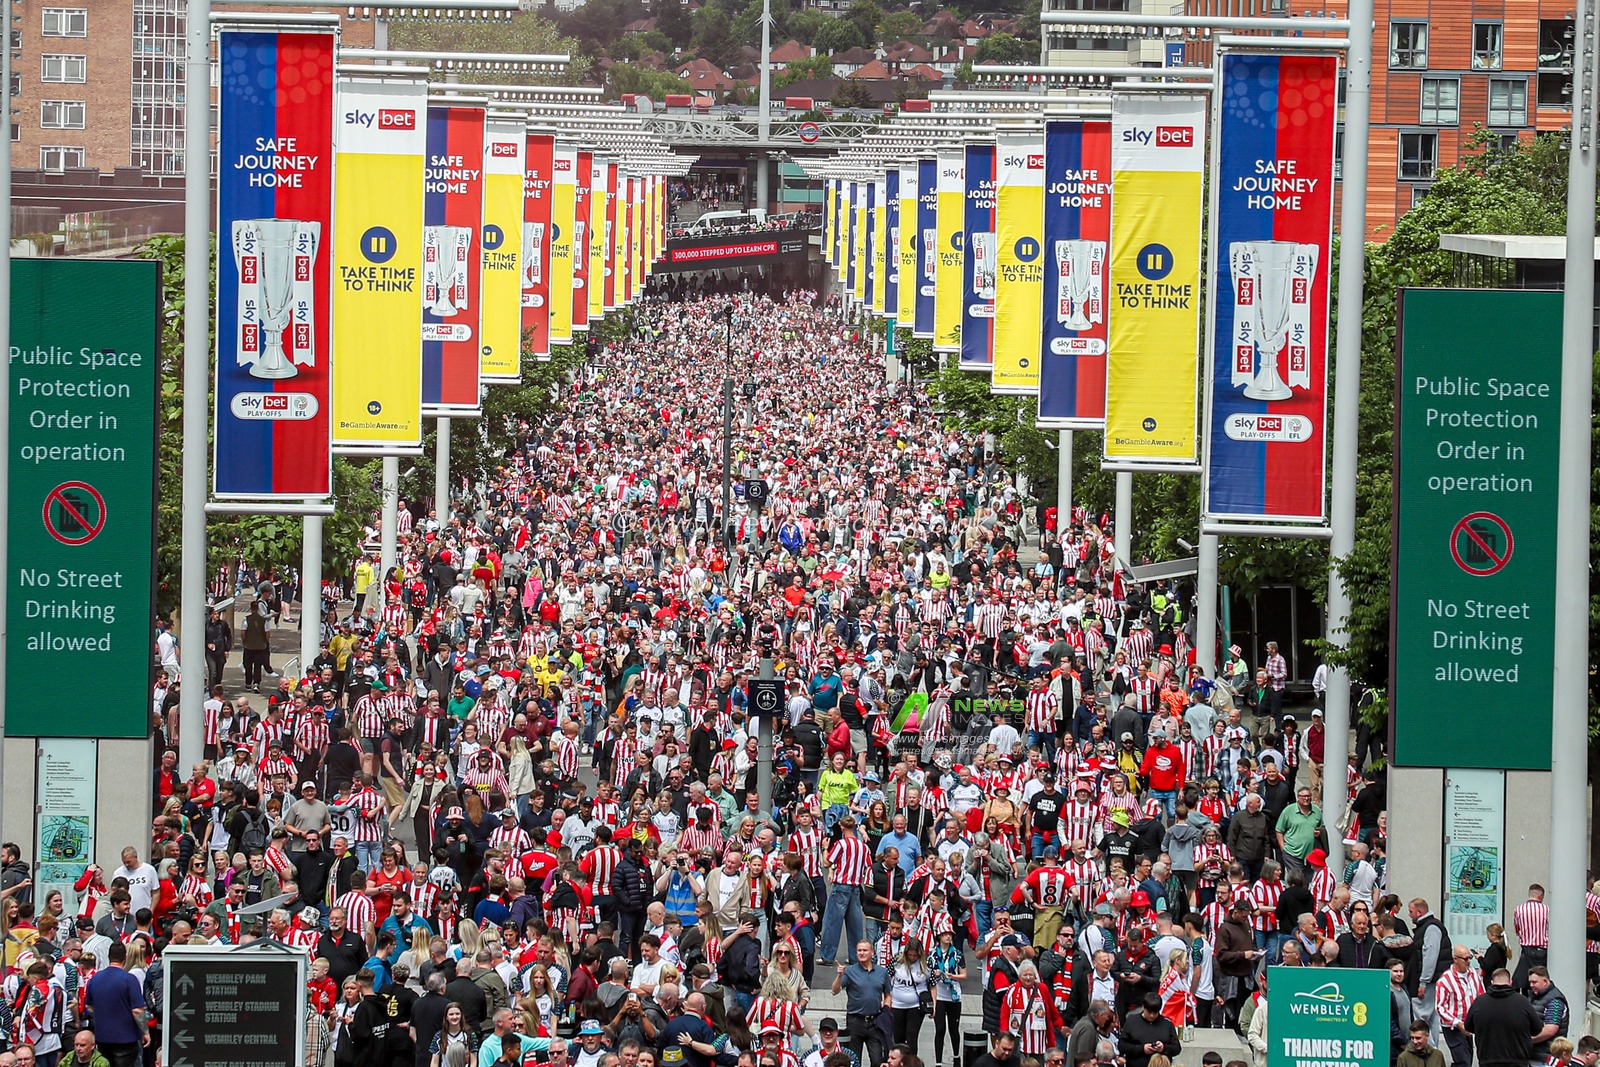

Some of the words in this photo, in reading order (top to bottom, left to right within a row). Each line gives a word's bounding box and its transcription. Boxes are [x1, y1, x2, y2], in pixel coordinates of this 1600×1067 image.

[345, 109, 375, 128] sky
[382, 111, 412, 126] bet
[664, 122, 734, 139] PARK
[1123, 128, 1153, 145] sky
[1160, 128, 1189, 143] bet
[256, 137, 296, 152] SAFE
[494, 144, 515, 155] bet
[234, 155, 318, 170] JOURNEY
[431, 155, 463, 167] SAFE
[1004, 156, 1024, 168] sky
[1029, 156, 1044, 167] be
[1255, 160, 1296, 174] SAFE
[249, 173, 303, 188] HOME
[425, 169, 480, 180] OURNEY
[1065, 169, 1098, 181] SAFE
[426, 183, 467, 194] HOME
[526, 180, 550, 189] RNEY
[979, 181, 996, 189] SAF
[1049, 183, 1112, 195] JOURNEY
[1233, 177, 1318, 193] JOURNEY
[967, 190, 996, 198] JOUR
[1060, 196, 1102, 208] HOME
[1248, 195, 1301, 210] HOME
[243, 231, 256, 254] sky
[494, 253, 516, 262] TIME
[675, 251, 698, 259] 300,000
[244, 258, 255, 281] bet
[298, 258, 307, 279] bet
[482, 261, 515, 270] THINK
[1000, 265, 1025, 274] TAKE
[1240, 253, 1253, 276] sky
[340, 266, 376, 279] TAKE
[380, 267, 415, 280] TIME
[344, 280, 363, 291] TO
[367, 280, 413, 292] THINK
[1117, 283, 1153, 295] TAKE
[1157, 284, 1191, 296] TIME
[1241, 280, 1251, 302] bet
[1295, 280, 1304, 301] bet
[1120, 296, 1139, 308] TO
[1142, 296, 1189, 309] THINK
[243, 300, 256, 322] sky
[296, 300, 309, 322] sky
[245, 326, 255, 350] bet
[298, 326, 307, 347] bet
[1239, 321, 1251, 343] sky
[1292, 323, 1304, 344] sky
[1057, 340, 1070, 349] sky
[9, 346, 73, 366] Public
[79, 348, 142, 369] Space
[1240, 348, 1250, 370] bet
[1293, 348, 1303, 369] bet
[19, 378, 130, 398] Protection
[1416, 376, 1480, 396] Public
[1487, 378, 1550, 400] Space
[241, 396, 261, 408] sky
[266, 397, 286, 407] bet
[29, 411, 92, 429] Order
[99, 412, 117, 429] in
[340, 421, 408, 430] BeGambleAware.org
[1235, 418, 1255, 430] sky
[1259, 419, 1279, 428] bet
[1426, 408, 1538, 429] Protection
[1115, 438, 1183, 447] BeGambleAware.org
[1437, 440, 1500, 460] Order
[1507, 442, 1524, 460] in
[20, 444, 125, 463] operation
[1428, 473, 1532, 494] operation
[20, 568, 50, 587] No
[57, 569, 122, 588] Street
[25, 599, 115, 624] Drinking
[1428, 599, 1457, 618] No
[1465, 600, 1530, 619] Street
[27, 632, 110, 651] allowed
[1433, 631, 1523, 655] Drinking
[1435, 663, 1518, 682] allowed
[331, 815, 349, 832] 50
[128, 877, 146, 885] OSS
[1043, 886, 1056, 904] 8
[206, 974, 244, 984] WEMBLEY
[245, 974, 267, 984] PARK
[205, 985, 237, 996] STATION
[205, 1001, 243, 1012] WEMBLEY
[245, 1002, 280, 1012] STADIUM
[1290, 1004, 1350, 1015] WEMBLEY
[205, 1013, 237, 1023] STATION
[205, 1034, 243, 1045] WEMBLEY
[244, 1035, 278, 1045] CENTRAL
[1283, 1038, 1341, 1058] THANKS
[1345, 1040, 1374, 1059] FOR
